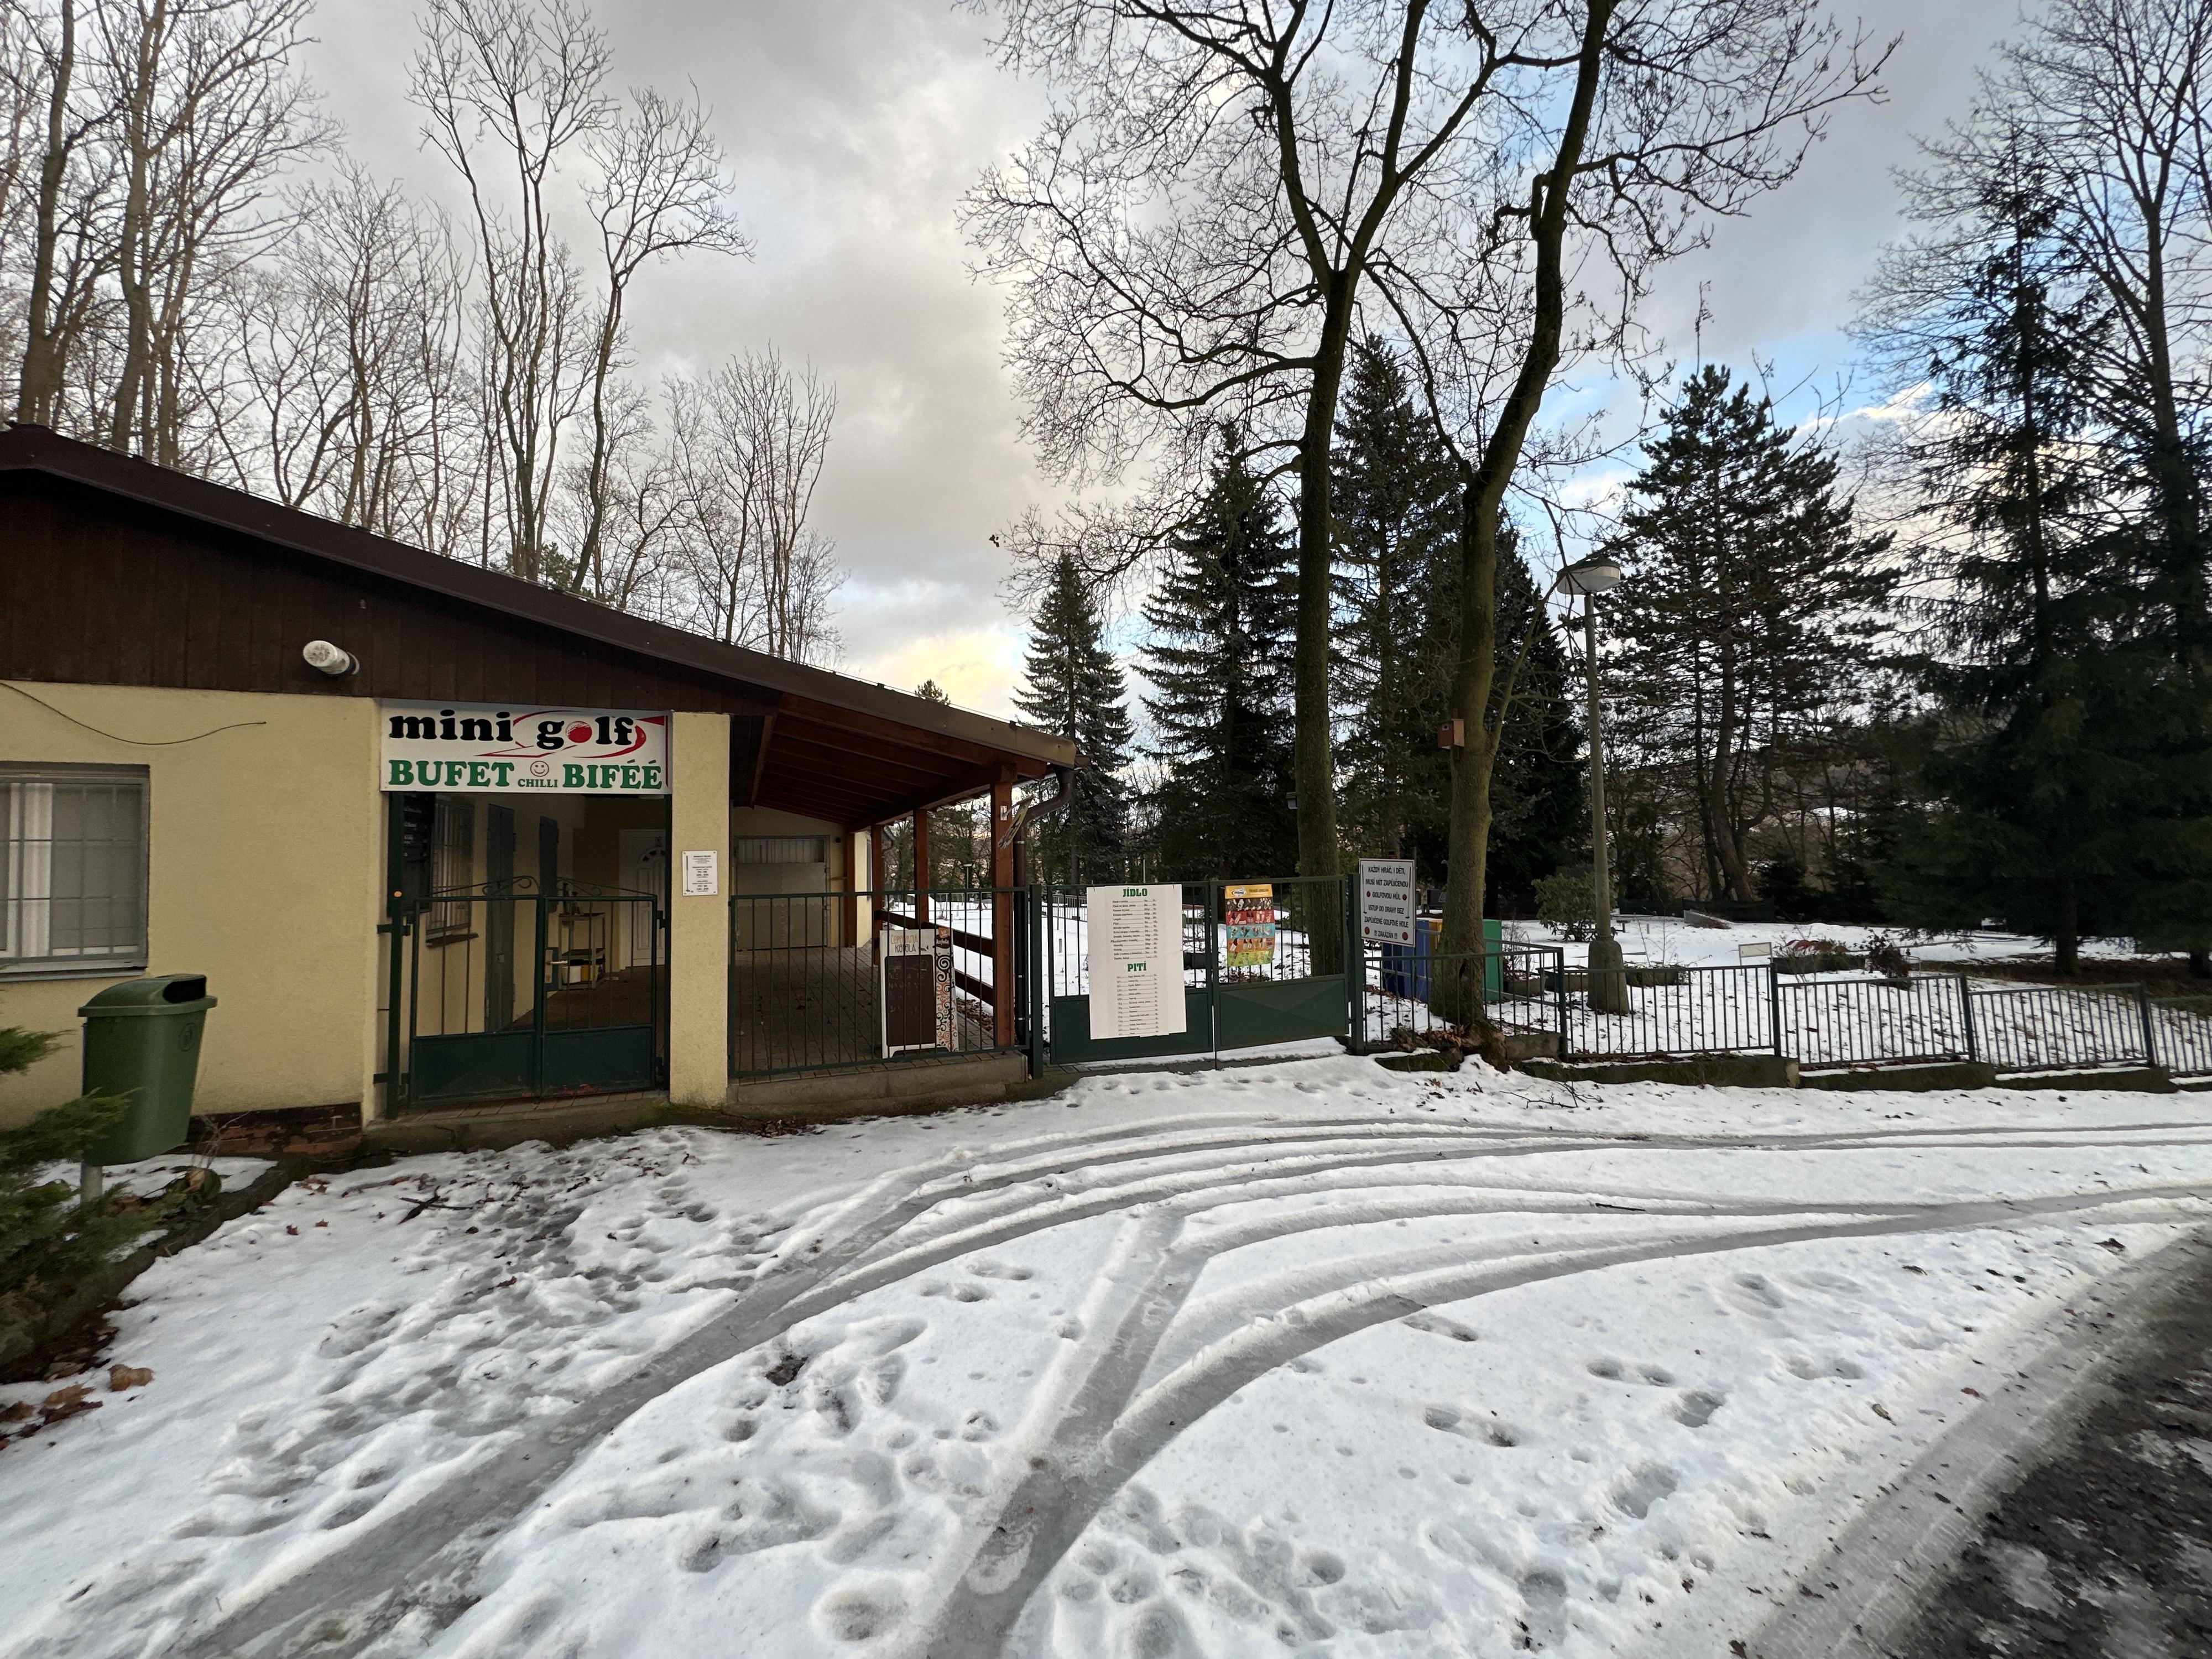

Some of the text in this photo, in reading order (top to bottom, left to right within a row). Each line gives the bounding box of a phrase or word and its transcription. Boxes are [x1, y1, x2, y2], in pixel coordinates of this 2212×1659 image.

[389, 709, 513, 742] mini
[388, 759, 515, 787] BUFET
[562, 759, 662, 790] BIFÉÉ
[517, 779, 559, 788] CHILLI
[1123, 887, 1147, 897] JÍDLO
[1127, 961, 1146, 972] PITÍ
